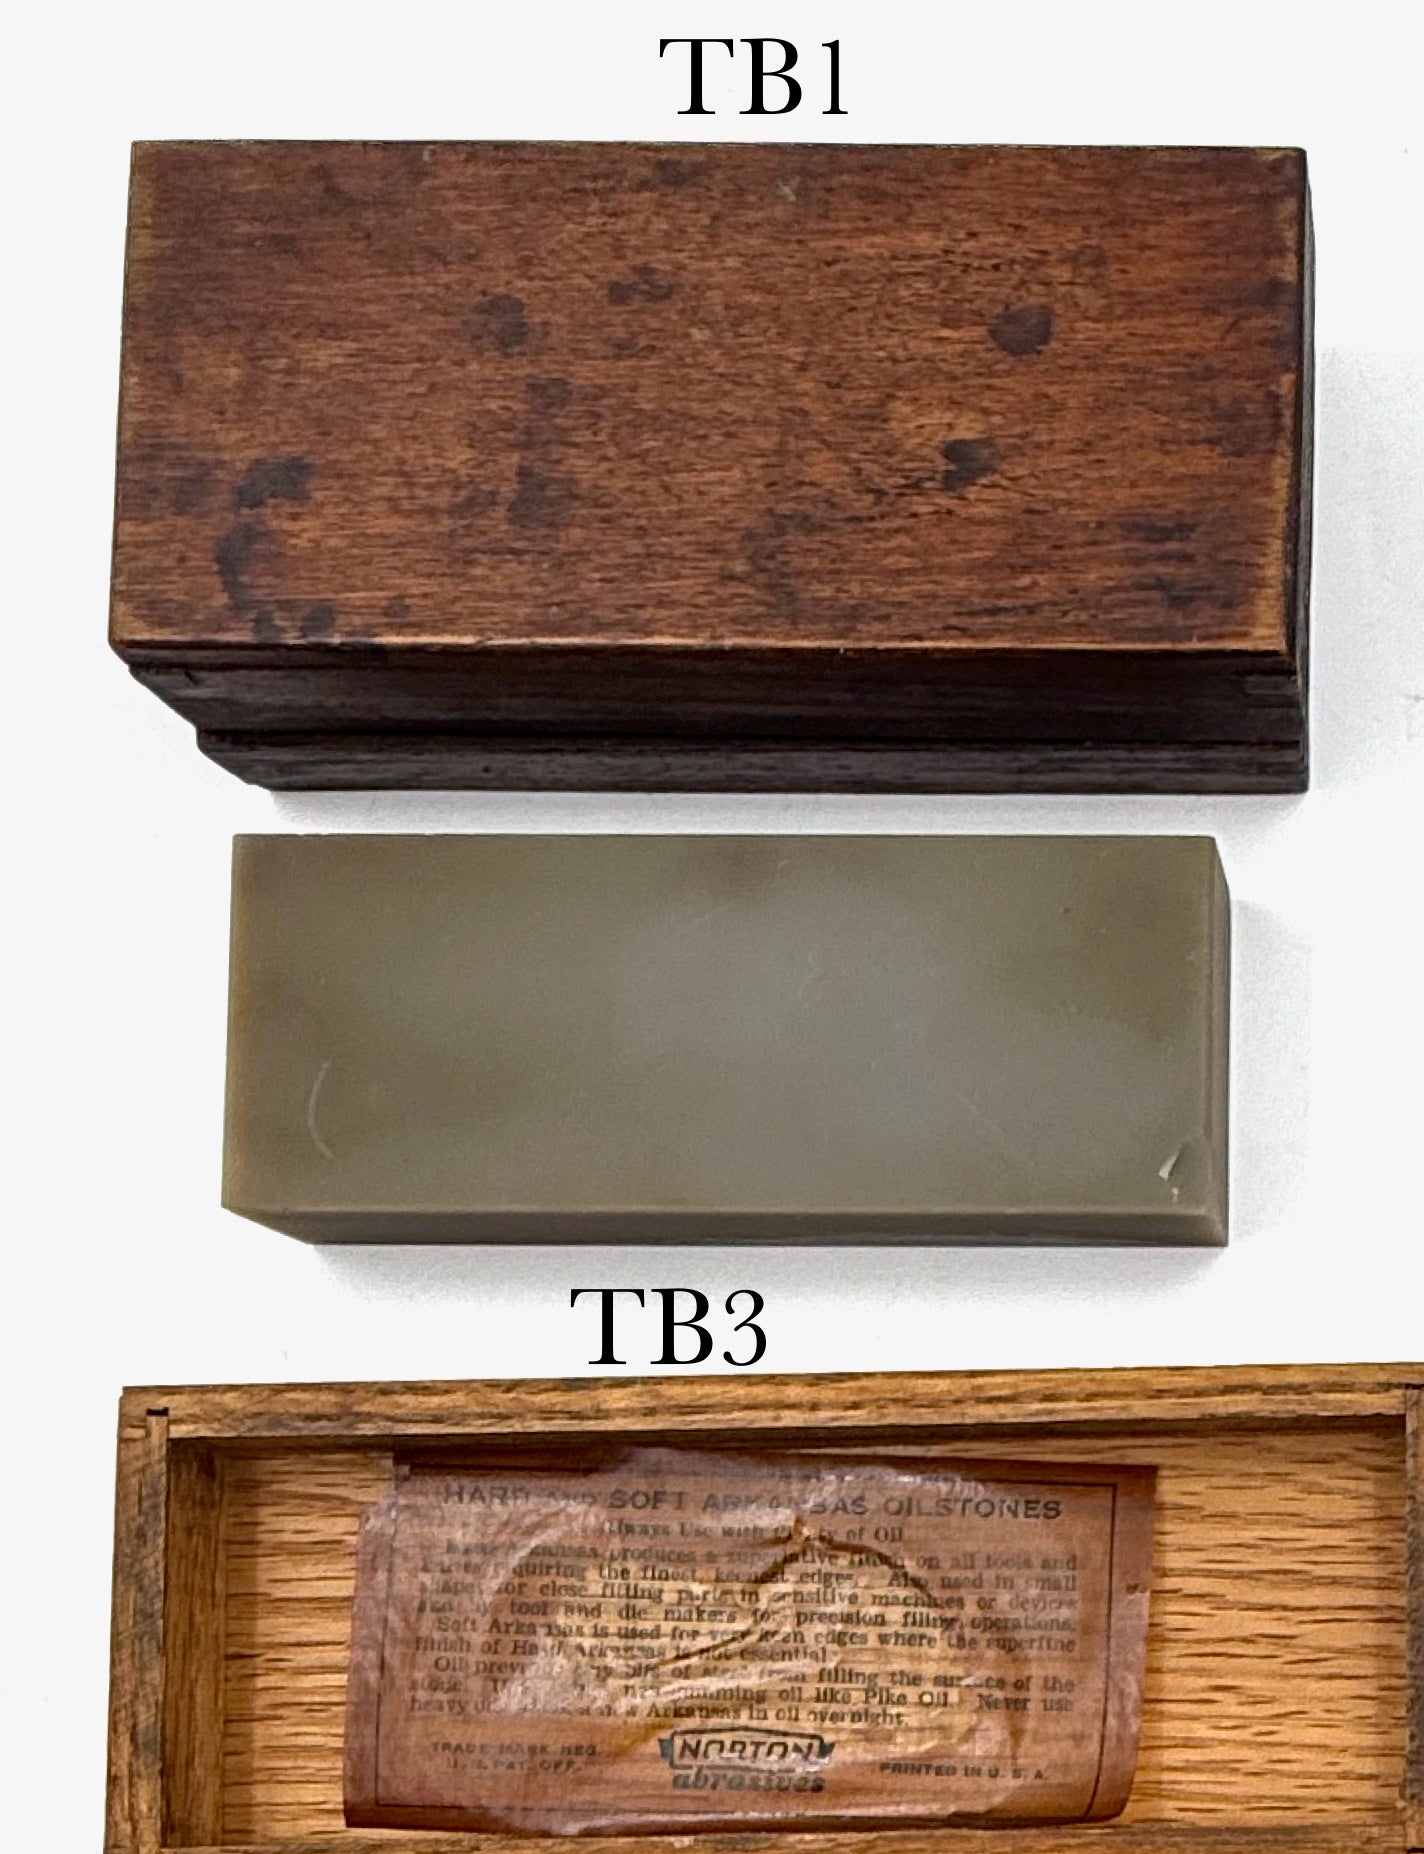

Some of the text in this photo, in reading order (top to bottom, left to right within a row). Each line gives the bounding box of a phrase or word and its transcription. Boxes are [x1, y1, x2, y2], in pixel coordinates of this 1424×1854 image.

[608, 1489, 690, 1511] SOFT
[883, 1496, 1062, 1519] OILSTONES
[796, 1609, 886, 1627] precision
[818, 1666, 878, 1688] filling
[679, 1737, 814, 1762] NORTON
